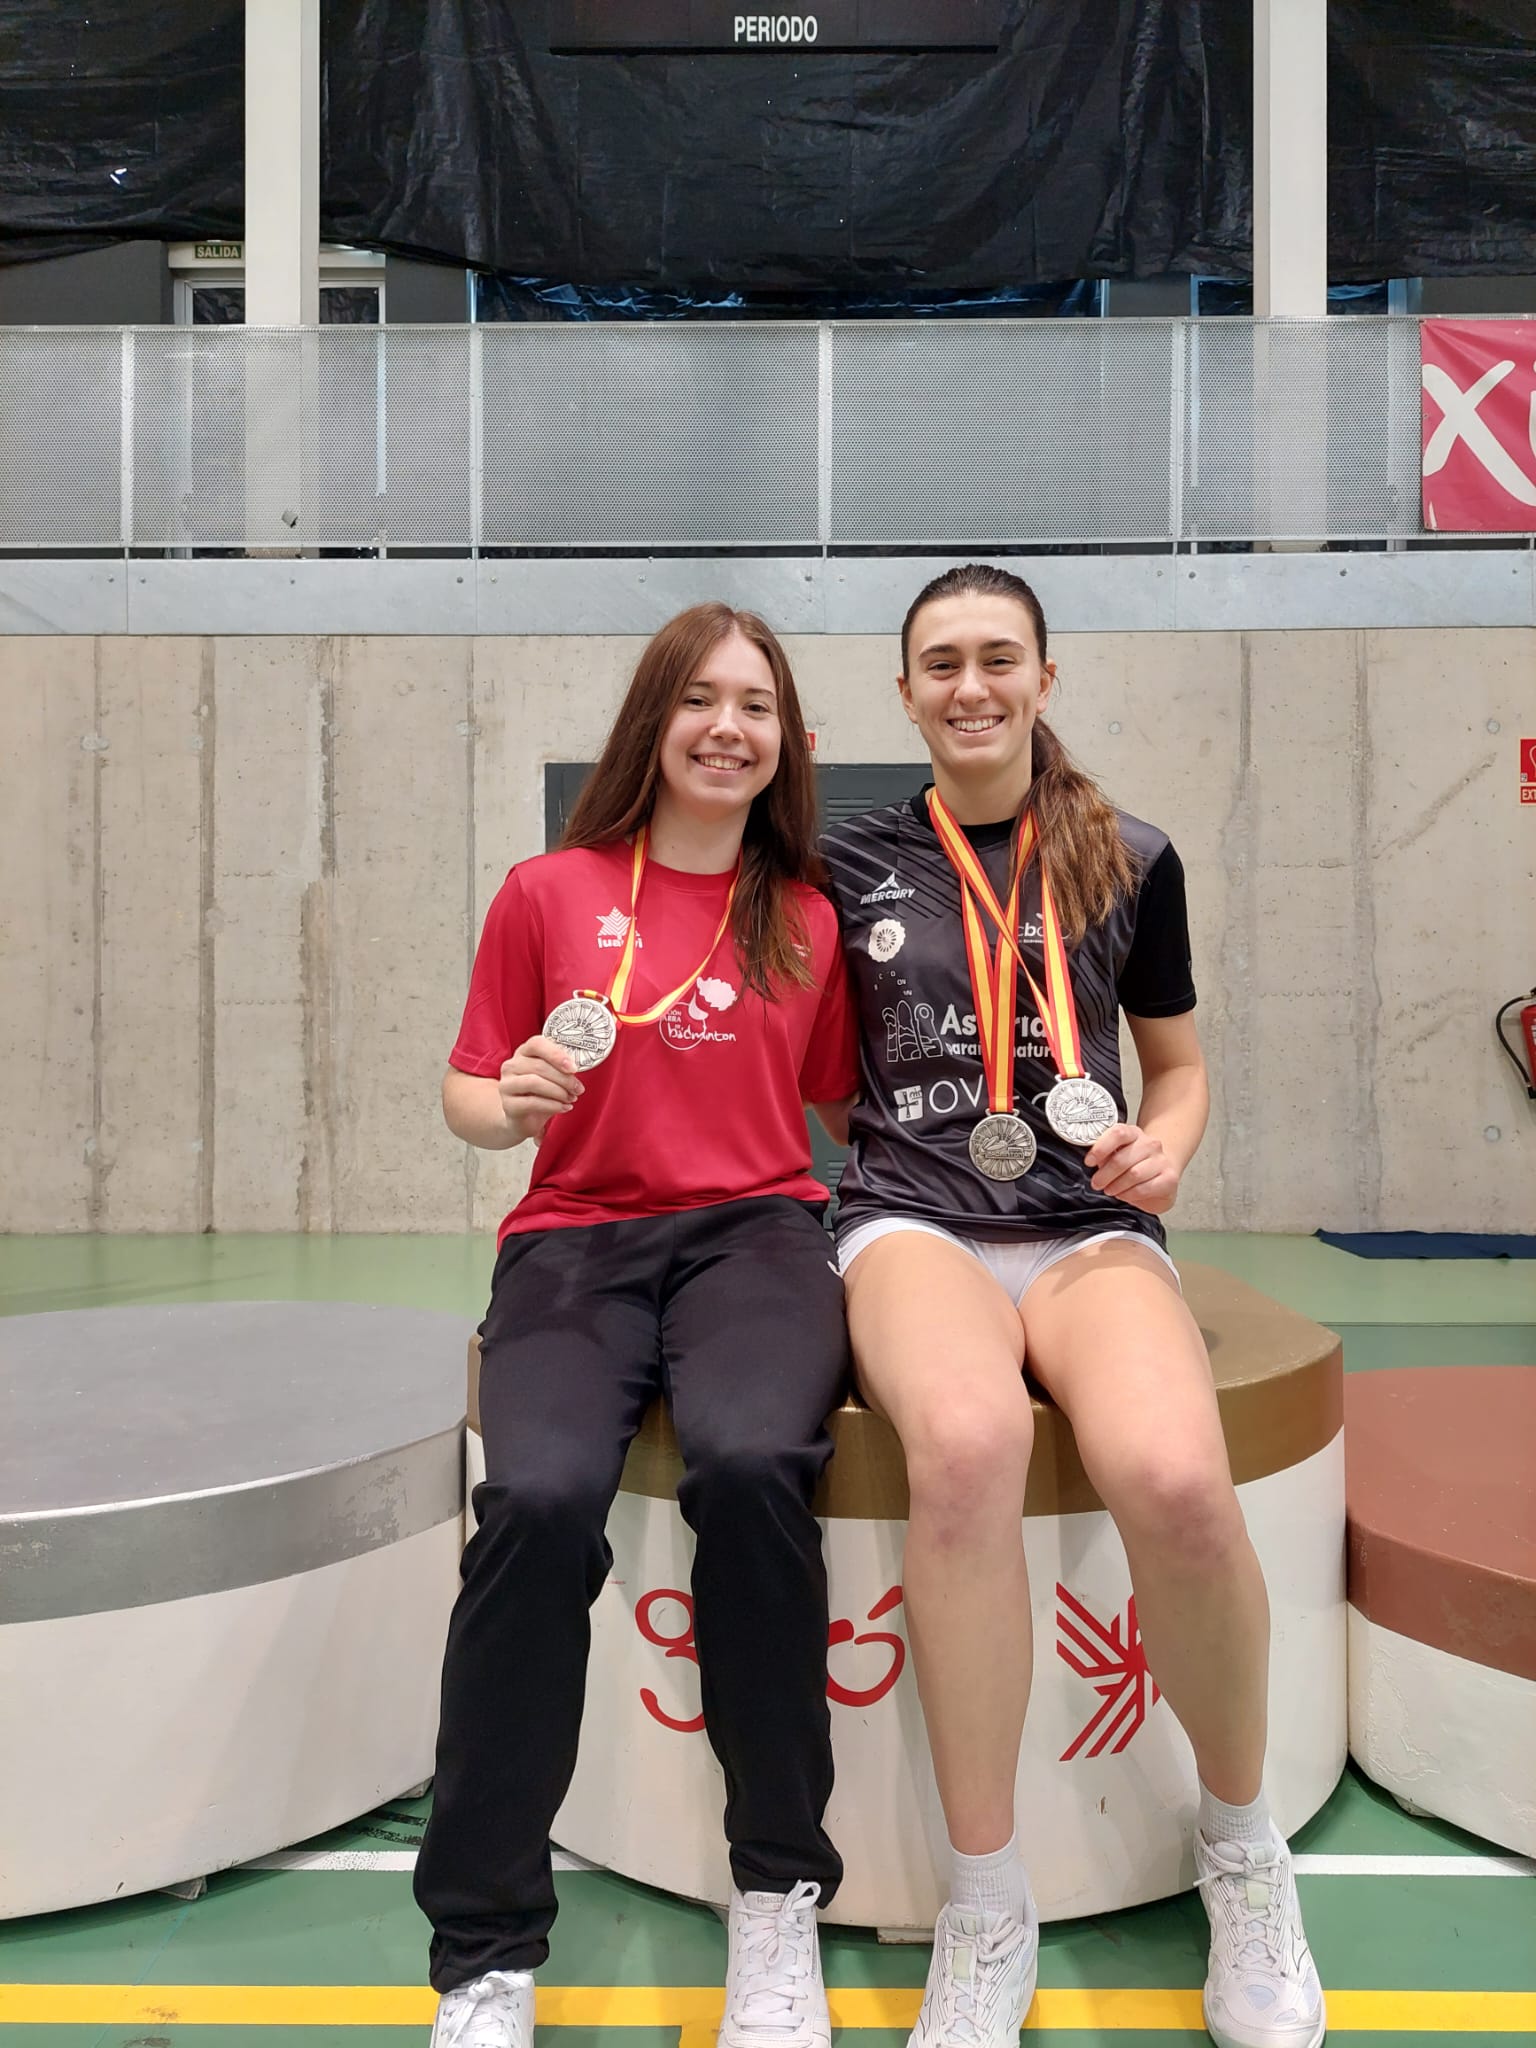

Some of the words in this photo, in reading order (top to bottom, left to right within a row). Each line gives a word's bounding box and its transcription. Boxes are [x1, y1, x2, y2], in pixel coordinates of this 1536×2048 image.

[734, 16, 818, 42] PERIODO
[197, 246, 239, 258] SALIDA
[860, 888, 916, 905] MERCURY
